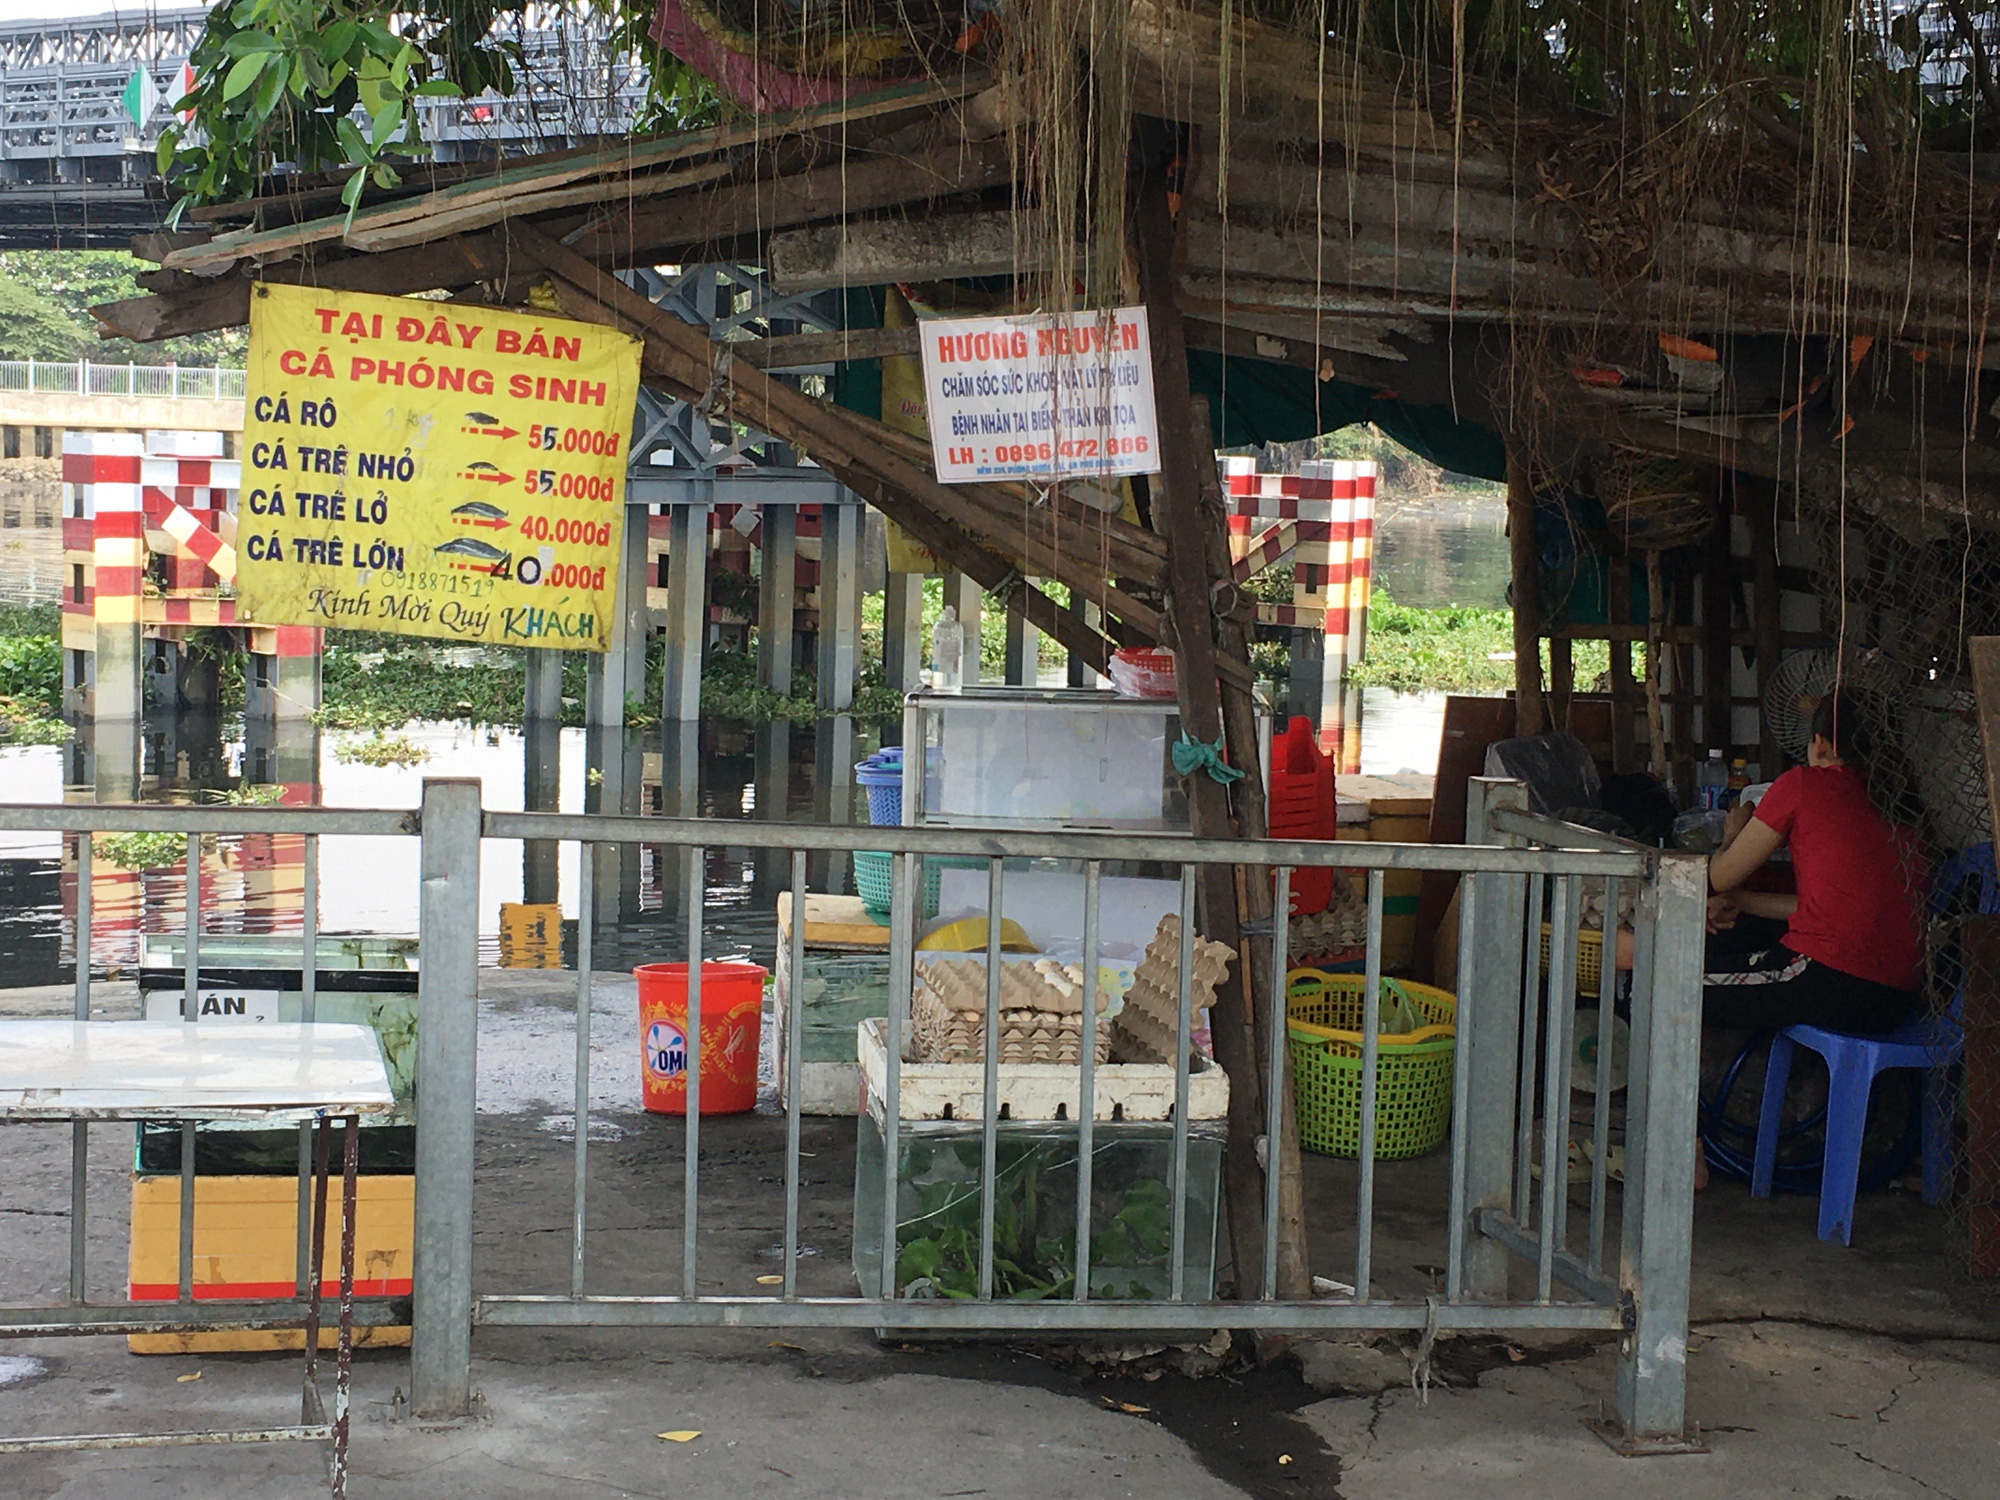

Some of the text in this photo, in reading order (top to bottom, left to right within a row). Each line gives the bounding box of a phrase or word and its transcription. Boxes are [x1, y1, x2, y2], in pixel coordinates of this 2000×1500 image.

[315, 308, 582, 362] TẠI ĐÂY BÁN
[938, 330, 1028, 363] HƯƠNG
[279, 346, 607, 407] CÁ PHÓNG SINH
[941, 371, 974, 398] CHĂM
[977, 368, 999, 396] SÓC
[1002, 367, 1024, 395] SỨC
[254, 391, 620, 457] CÁ RÔ 55.000đ
[952, 410, 979, 441] BỆNH
[981, 408, 1011, 435] NHÂN
[1013, 410, 1029, 433] TAI
[252, 437, 614, 503] CÁ TRÊ NHỎ 55.000đ
[948, 447, 974, 465] LH
[995, 443, 1051, 464] 0896
[1059, 439, 1099, 458] 472
[249, 483, 286, 516] CÁ
[355, 489, 388, 525] LỞ
[520, 515, 612, 547] 40.000đ
[247, 529, 606, 591] CÁ TRÊ LỚN 40.000đ
[306, 589, 372, 619] Kính
[377, 594, 432, 622] Mời
[438, 603, 491, 637] Quý
[657, 1050, 688, 1072] OM
